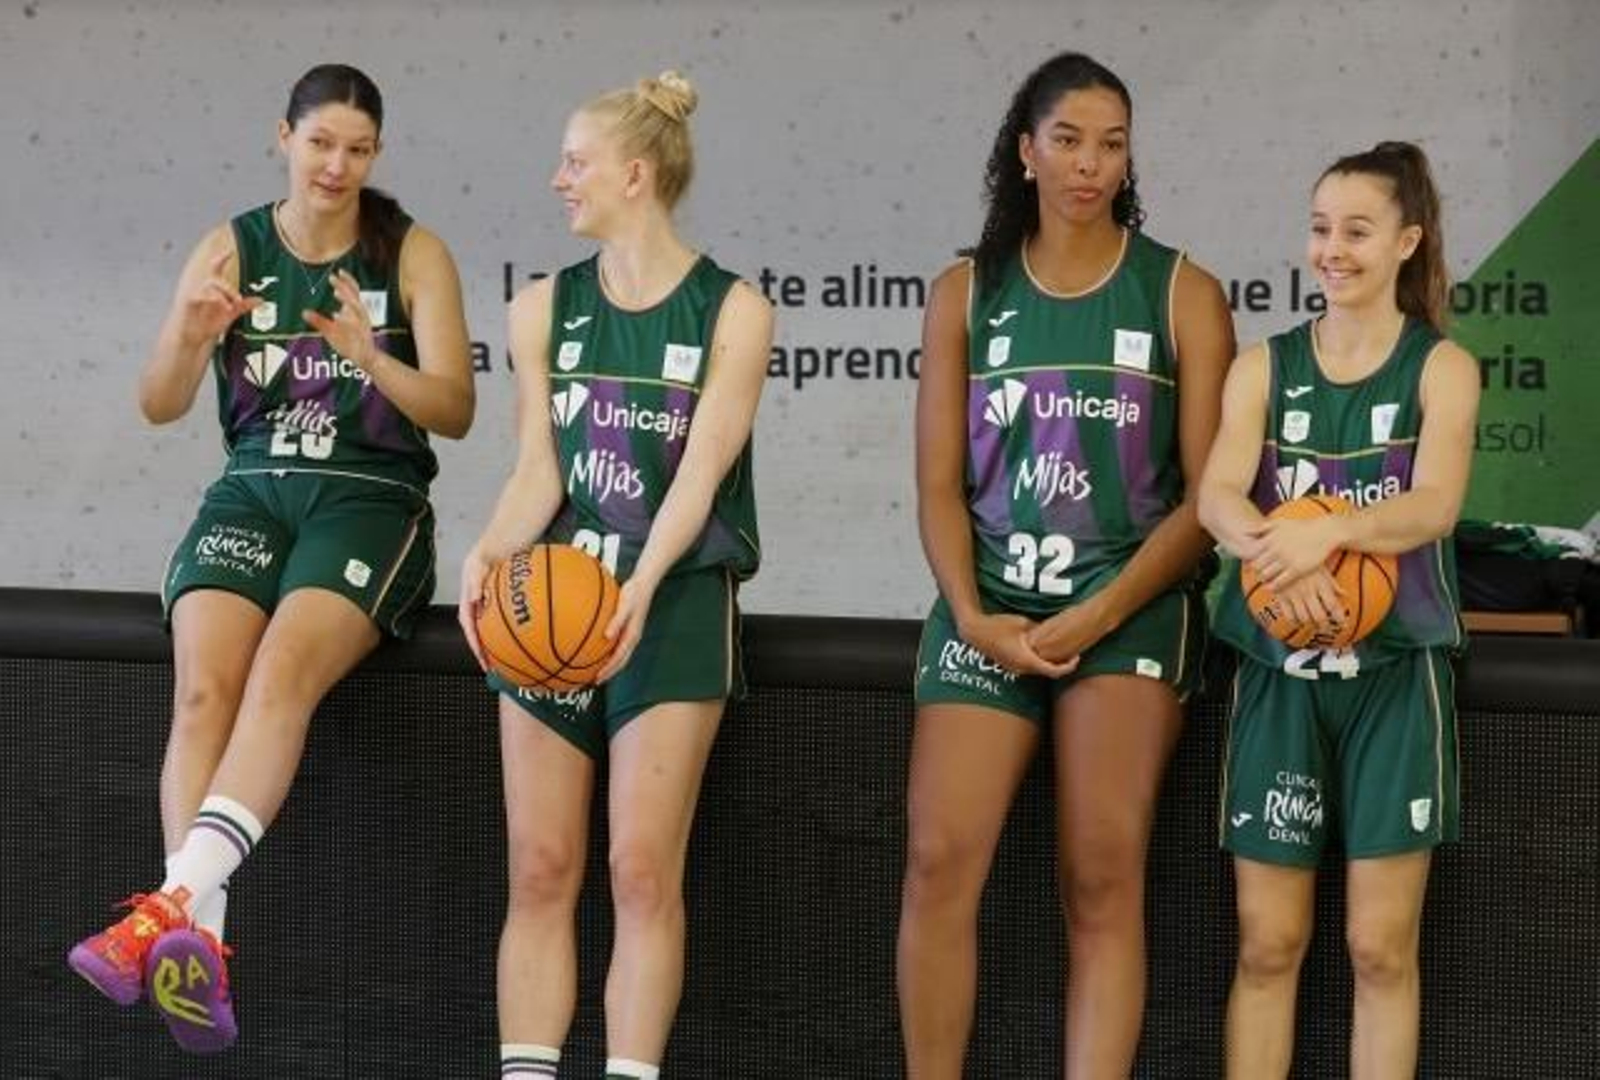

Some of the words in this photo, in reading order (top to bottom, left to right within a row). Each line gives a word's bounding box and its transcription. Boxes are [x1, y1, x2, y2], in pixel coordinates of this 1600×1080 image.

[760, 267, 806, 307] te
[822, 264, 925, 308] alim
[1450, 271, 1548, 316] oria
[1480, 345, 1547, 391] ria
[592, 400, 688, 442] Unicaja
[1033, 391, 1140, 428] Unicaja
[568, 449, 645, 502] Mijas
[1013, 453, 1092, 508] Mijas
[1004, 533, 1077, 595] 32
[940, 669, 1002, 695] DENTAL
